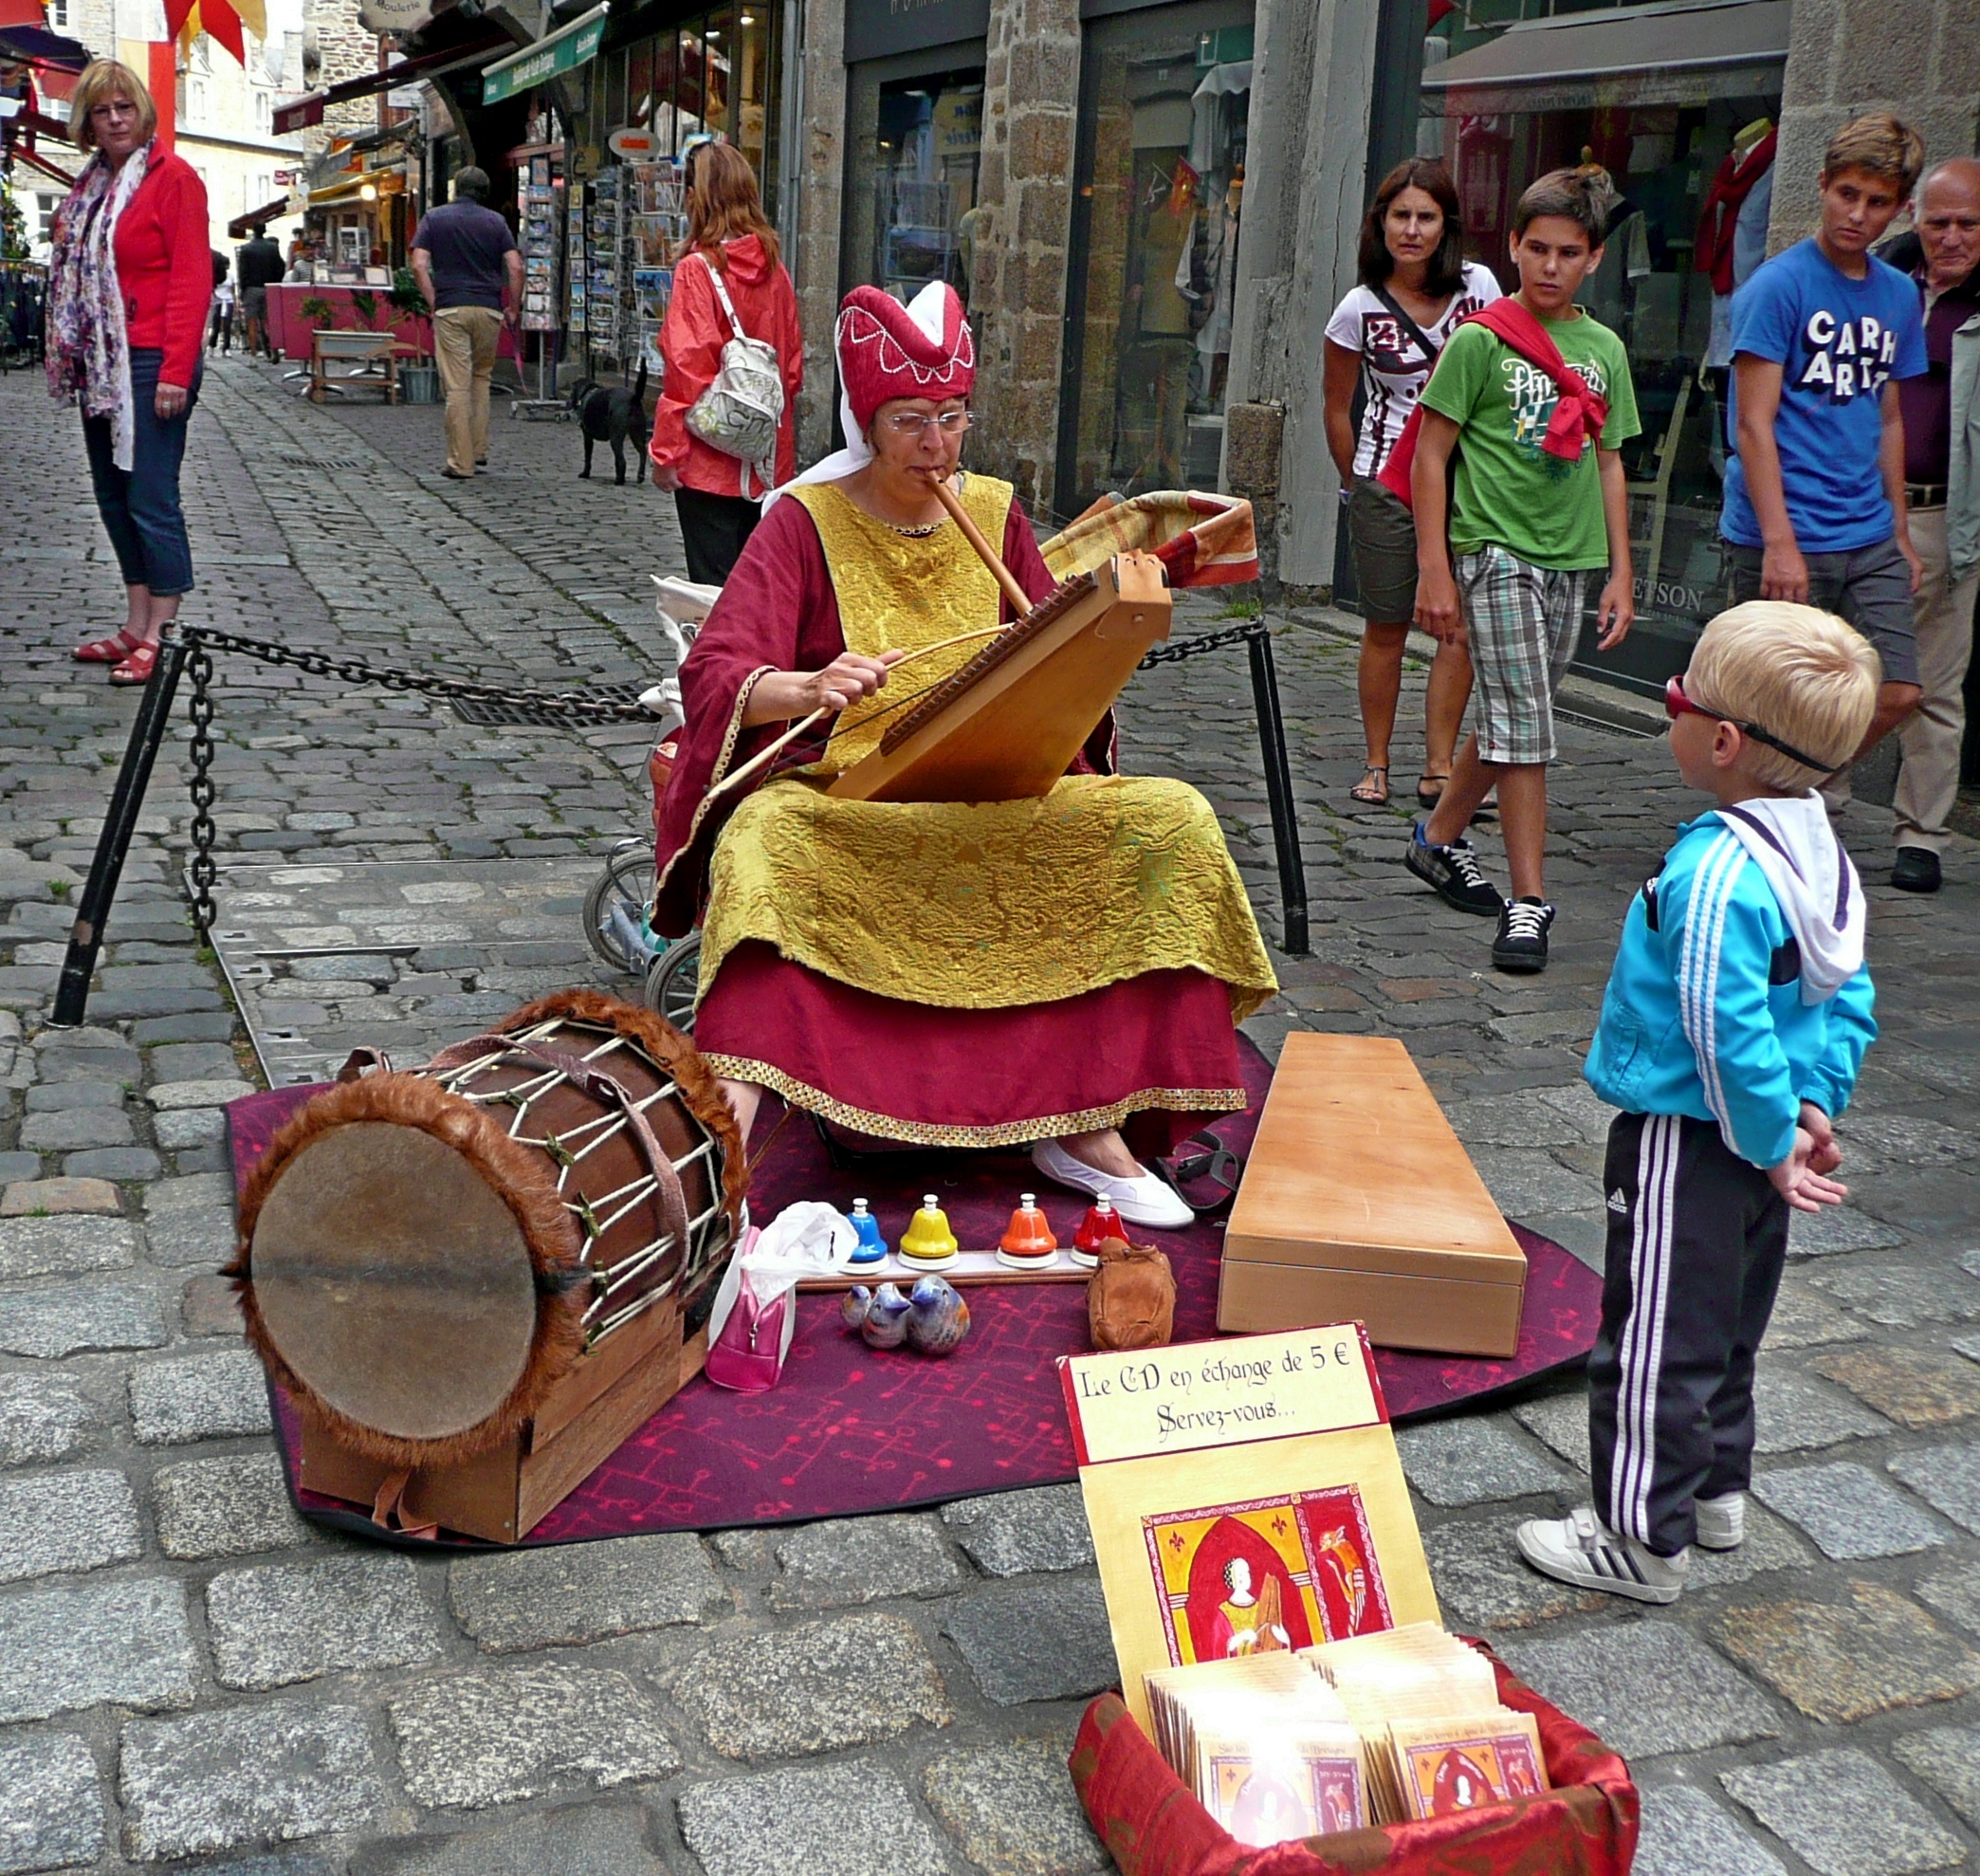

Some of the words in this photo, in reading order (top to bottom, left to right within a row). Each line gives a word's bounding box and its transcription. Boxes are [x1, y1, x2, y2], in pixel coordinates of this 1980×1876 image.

[1807, 310, 1898, 364] CARH
[1076, 1371, 1111, 1397] Le
[1120, 1363, 1160, 1392] CD
[1170, 1370, 1192, 1395] en
[1201, 1356, 1273, 1390] échange
[1282, 1350, 1303, 1372] de
[1311, 1346, 1325, 1369] 5
[1334, 1342, 1350, 1365] €
